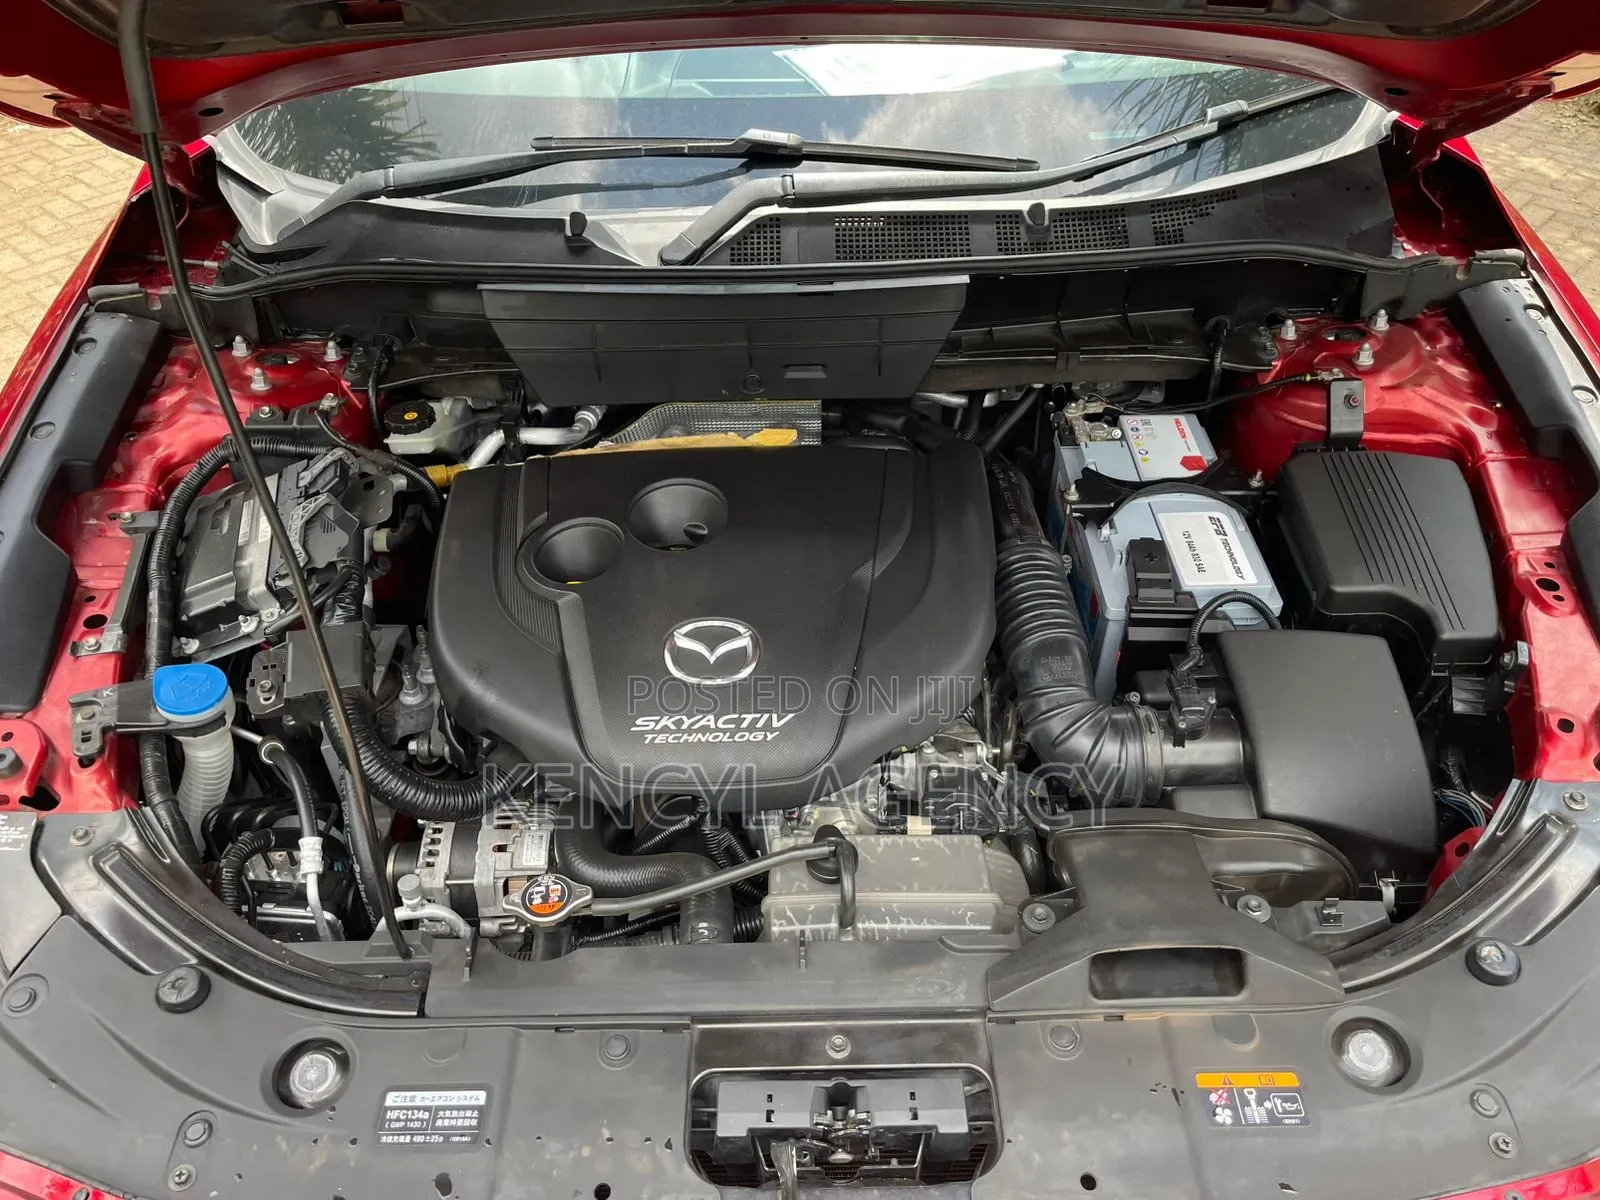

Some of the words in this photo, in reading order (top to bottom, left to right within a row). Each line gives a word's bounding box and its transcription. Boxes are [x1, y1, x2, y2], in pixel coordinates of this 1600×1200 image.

[1220, 538, 1245, 580] TECHNOLOGY
[1195, 563, 1207, 573] SAE
[630, 713, 796, 731] SKYACTIV
[643, 730, 780, 744] TECHNOLOGY
[386, 1109, 429, 1119] HFC134a
